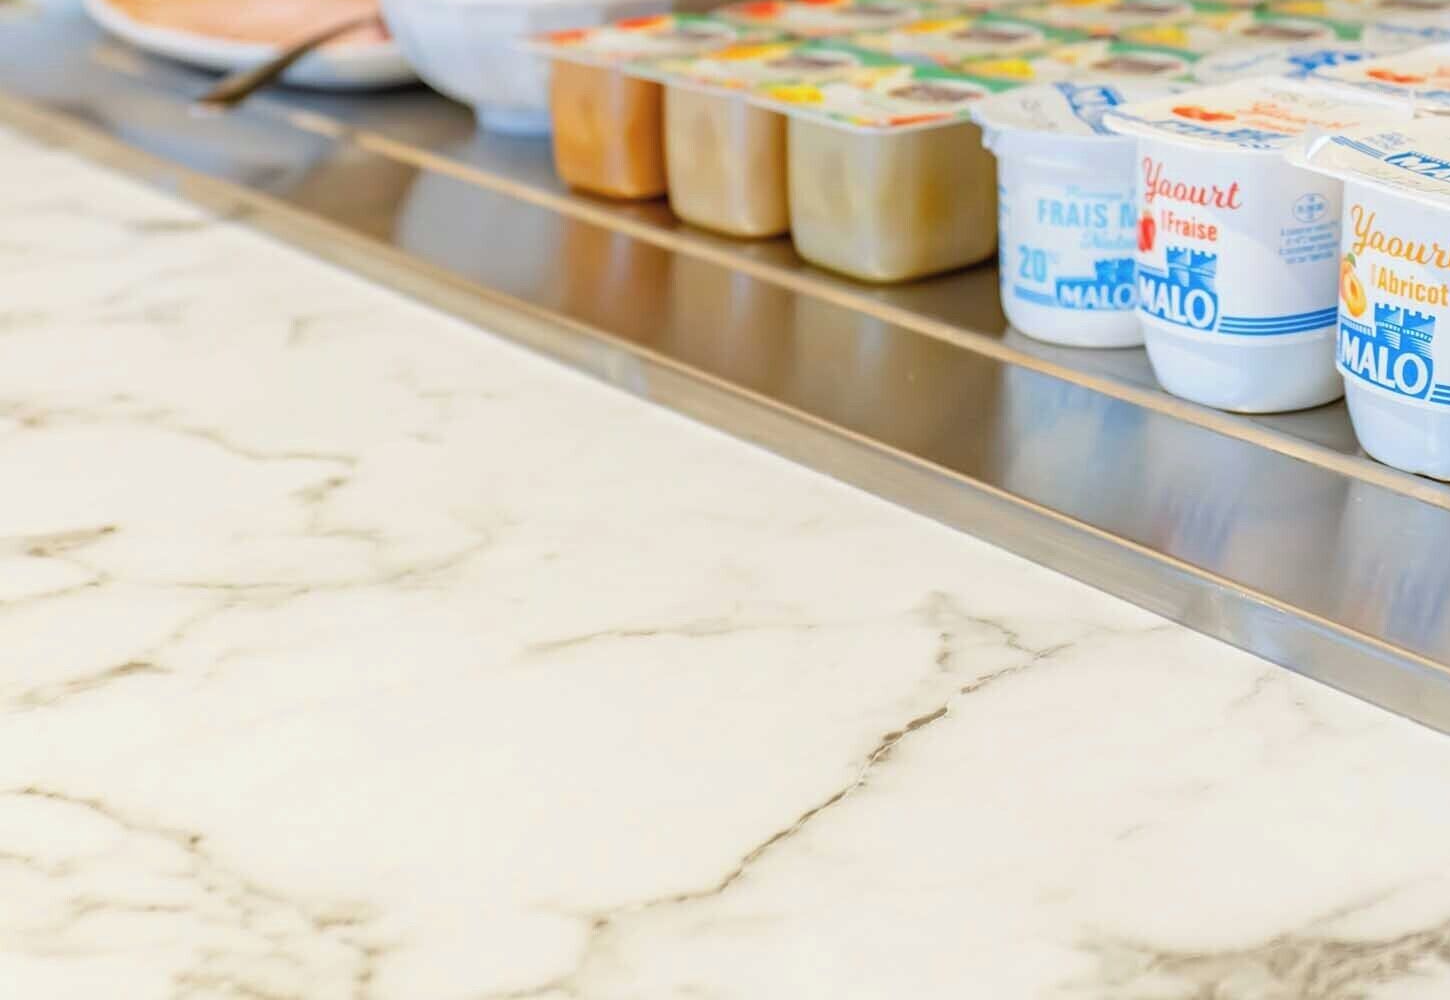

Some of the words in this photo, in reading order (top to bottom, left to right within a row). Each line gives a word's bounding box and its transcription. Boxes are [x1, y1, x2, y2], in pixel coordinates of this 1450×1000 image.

[1142, 156, 1242, 210] Yaourt
[1038, 198, 1108, 229] FRAIS
[1060, 283, 1135, 306] MALO
[1340, 327, 1428, 396] MALO
